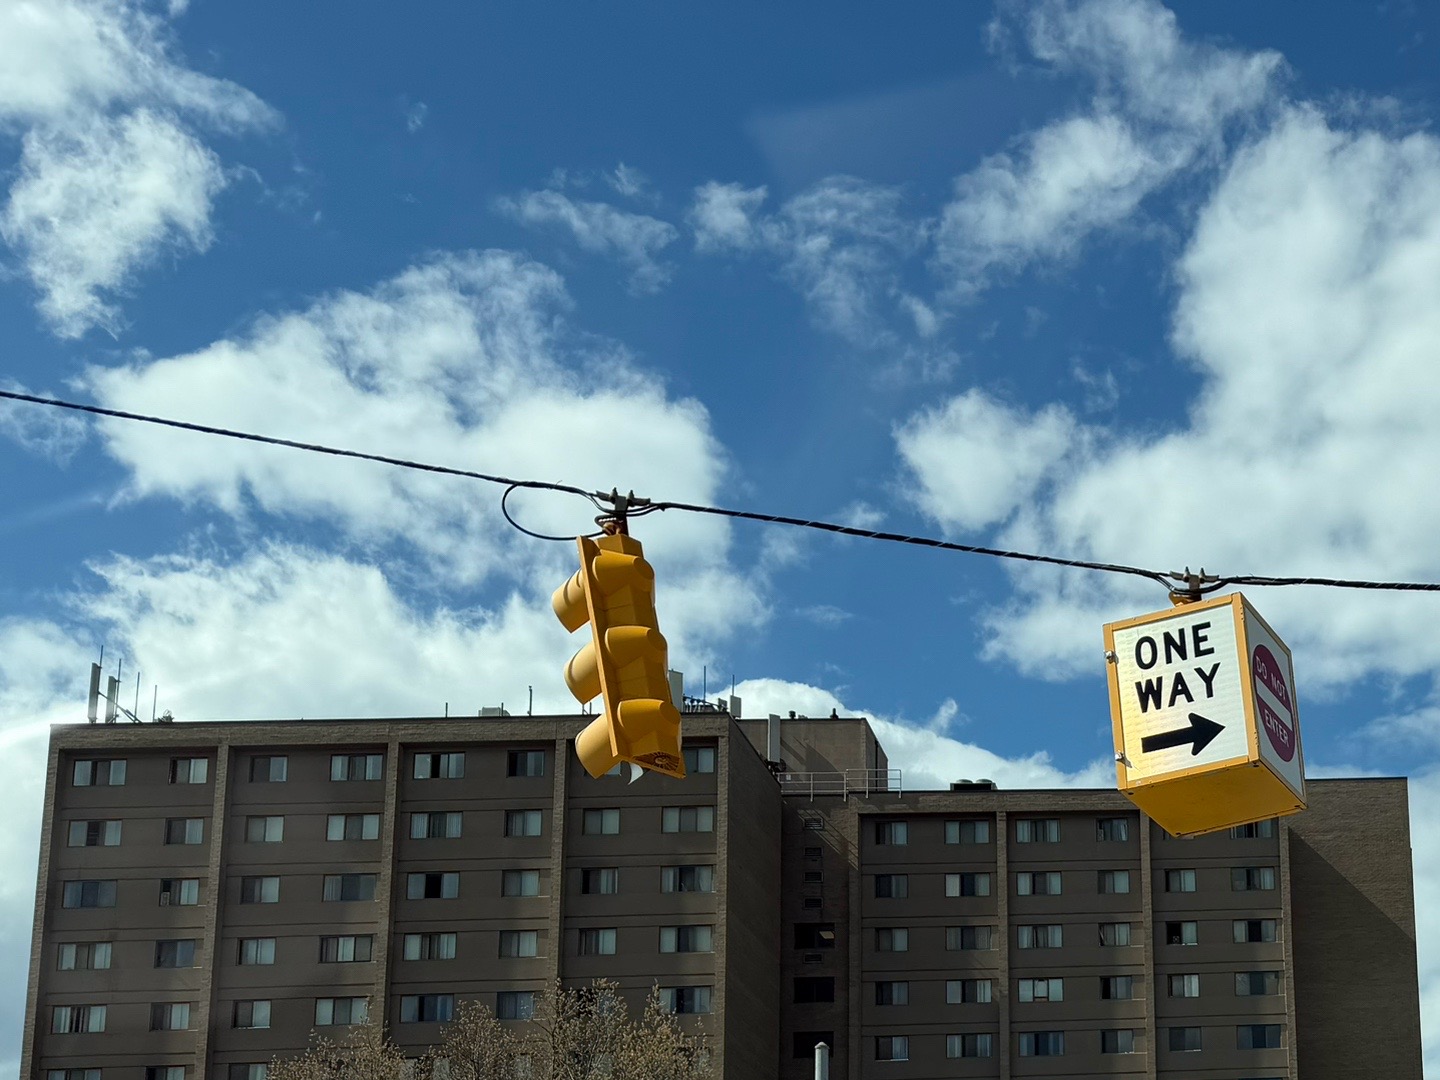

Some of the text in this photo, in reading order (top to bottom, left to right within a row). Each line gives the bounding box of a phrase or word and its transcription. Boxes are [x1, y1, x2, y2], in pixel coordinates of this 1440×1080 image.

[1135, 621, 1215, 670] ONE
[1135, 662, 1221, 713] WAY
[1256, 656, 1286, 700] DO NOT
[1264, 709, 1289, 747] ENTER
